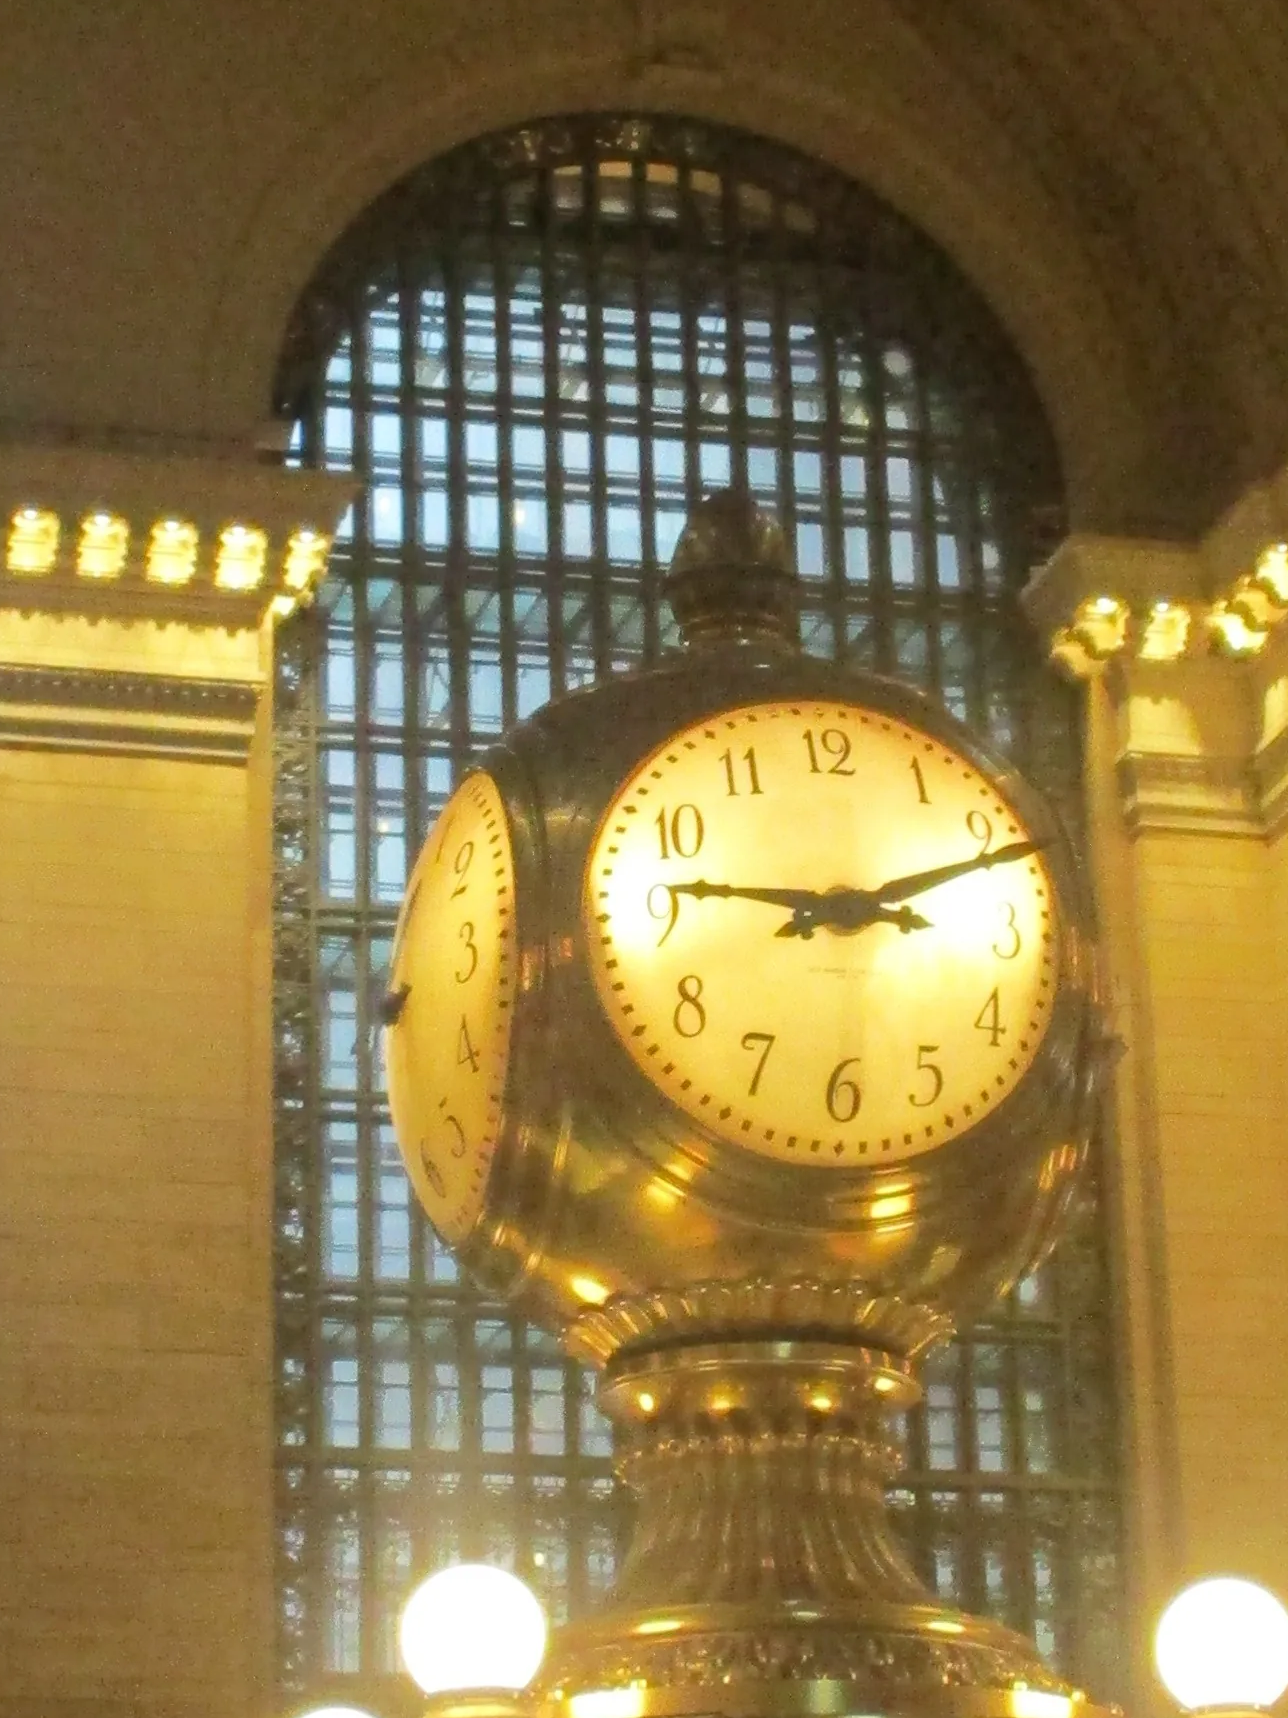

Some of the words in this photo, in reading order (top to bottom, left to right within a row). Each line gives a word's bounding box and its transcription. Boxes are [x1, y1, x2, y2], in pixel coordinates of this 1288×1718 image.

[718, 747, 764, 797] 11
[802, 728, 856, 777] 12
[909, 756, 931, 804] 1
[654, 804, 704, 860] 10
[450, 841, 475, 901] 2
[646, 884, 680, 949] 9
[991, 901, 1021, 960] 3
[455, 921, 478, 984] 3
[673, 975, 705, 1037] 8
[975, 987, 1007, 1047] 4
[457, 1015, 480, 1074] 4
[742, 1034, 776, 1096] 7
[826, 1058, 862, 1123] 6
[908, 1046, 942, 1108] 5
